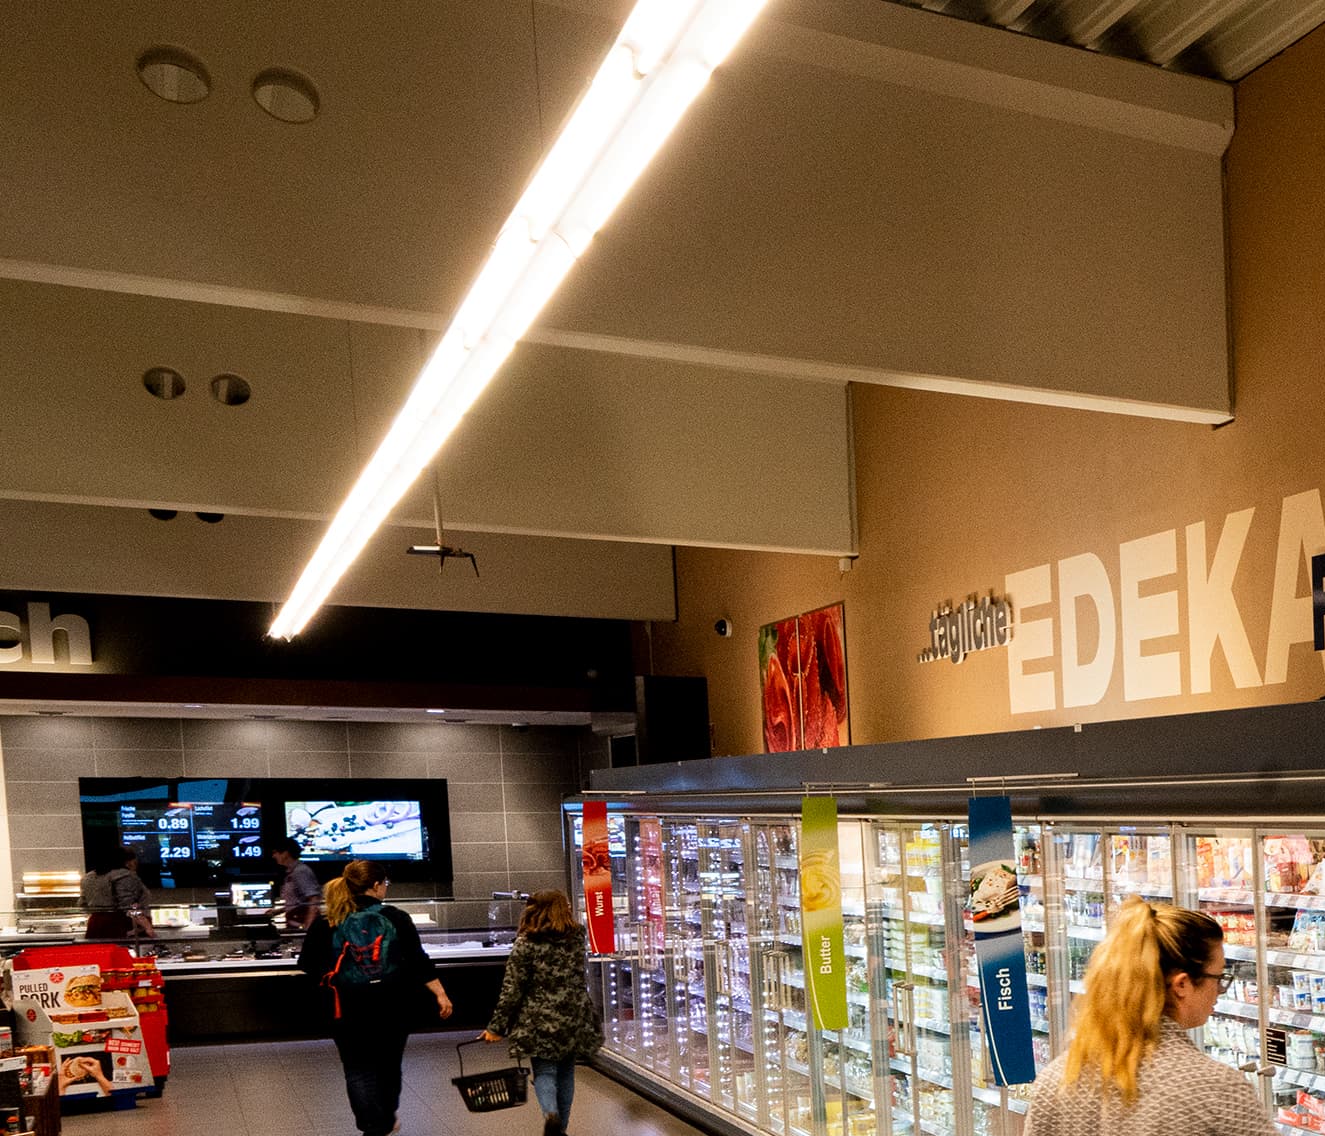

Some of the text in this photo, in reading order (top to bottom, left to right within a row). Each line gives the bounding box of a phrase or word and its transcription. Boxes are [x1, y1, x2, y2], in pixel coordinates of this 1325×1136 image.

[158, 818, 188, 829] 0.89
[231, 818, 260, 828] 1.99
[161, 847, 190, 857] 2.29
[233, 847, 261, 856] 1.49
[594, 891, 604, 917] Wurst
[820, 935, 832, 975] Butter
[20, 983, 48, 993] PULLED
[998, 968, 1012, 1010] Fisch
